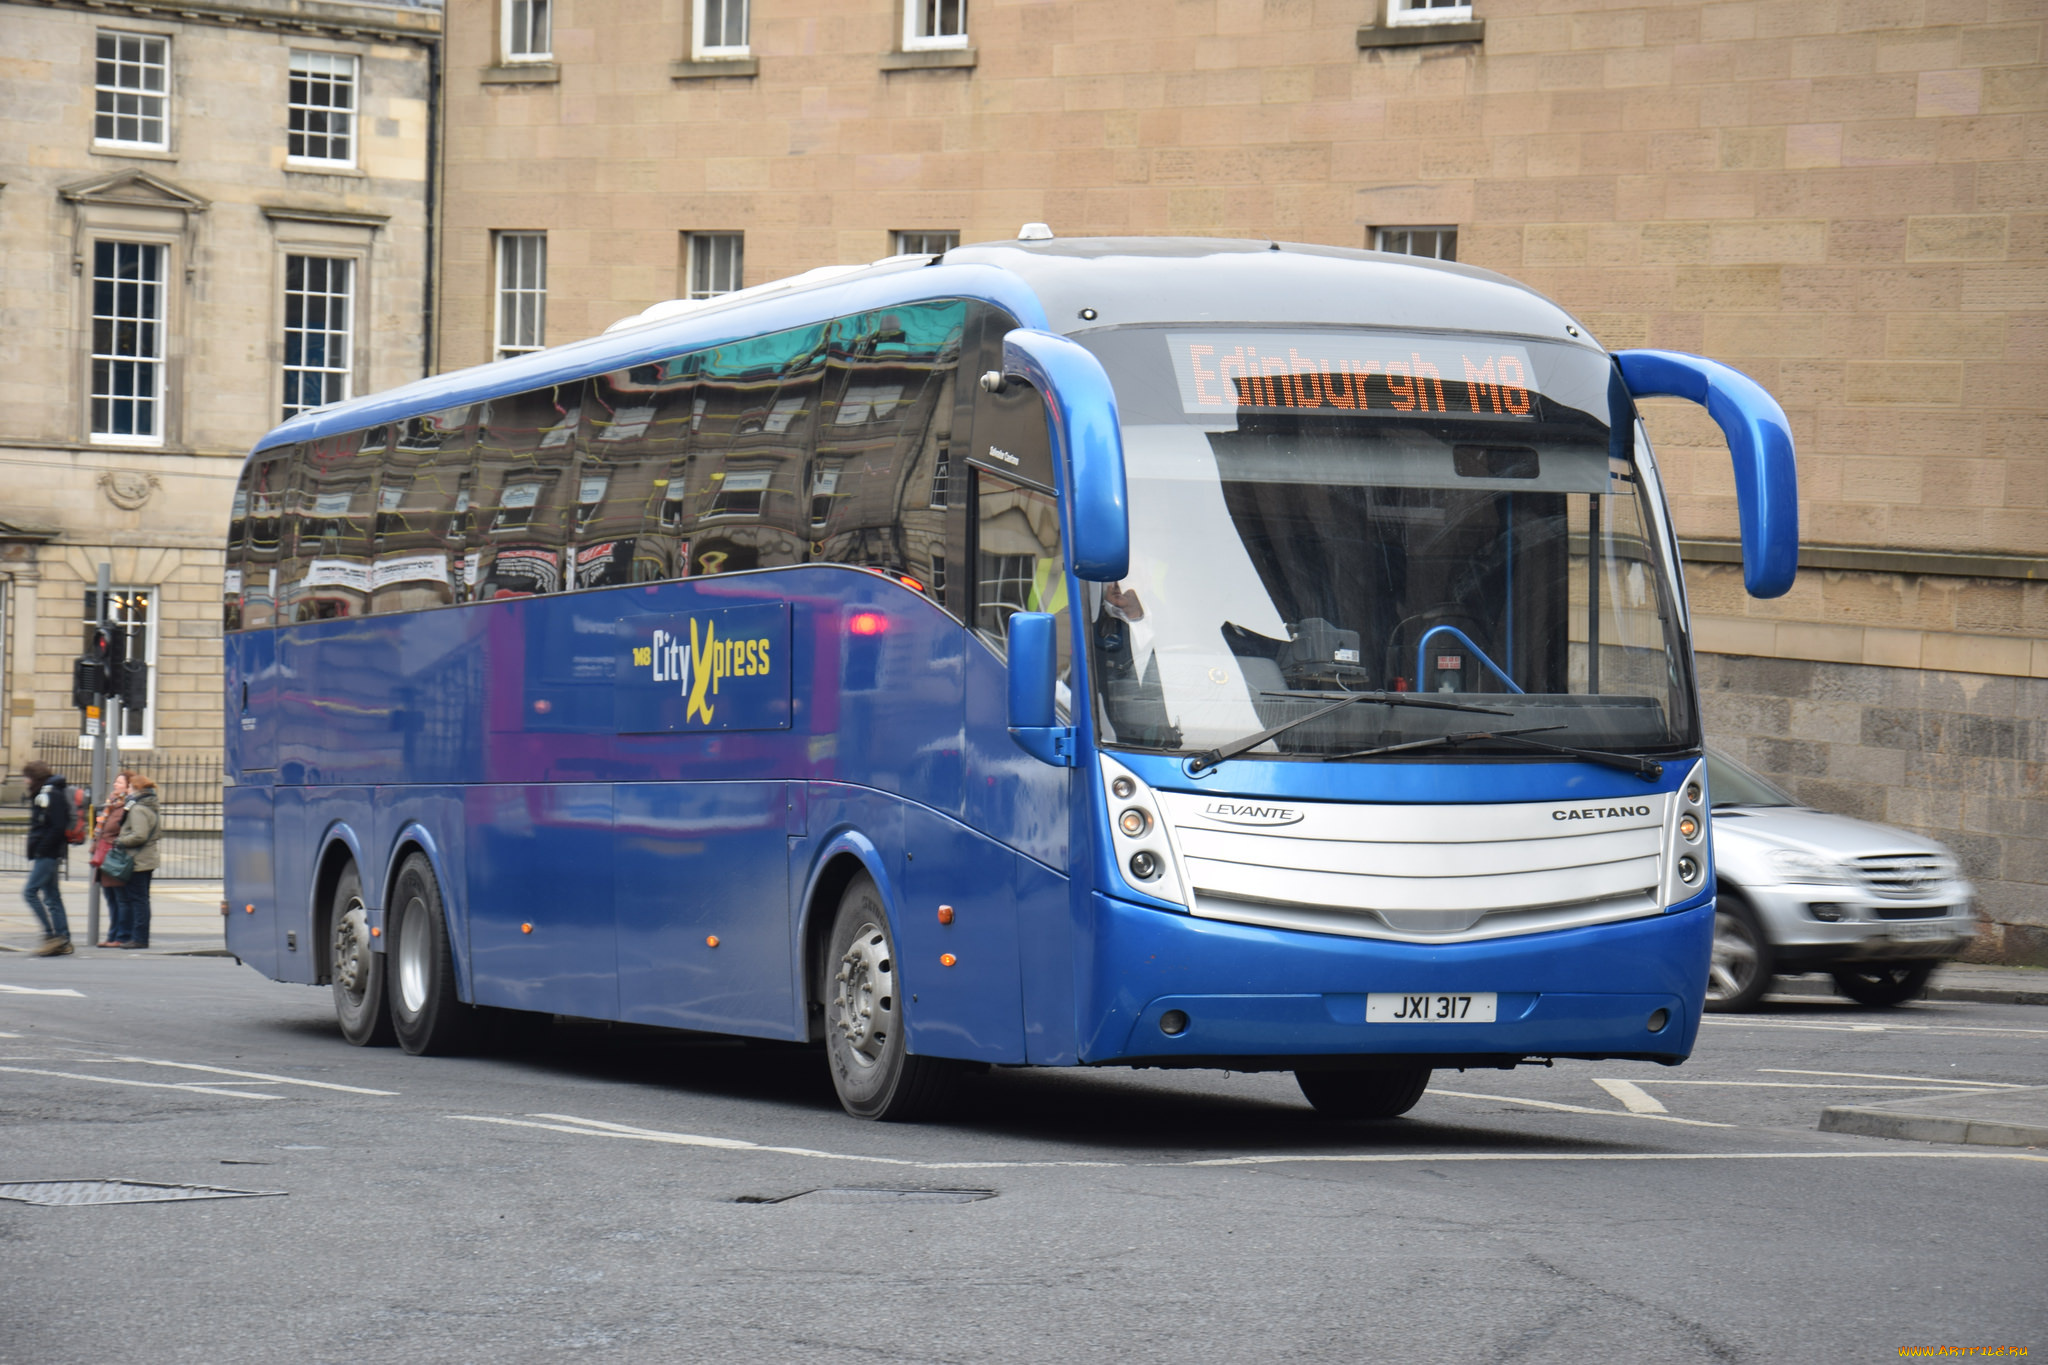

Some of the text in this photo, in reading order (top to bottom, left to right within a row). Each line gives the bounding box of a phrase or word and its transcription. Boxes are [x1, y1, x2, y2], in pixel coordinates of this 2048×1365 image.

[1190, 344, 1530, 415] Edinburgh M8
[632, 646, 651, 666] M8
[1205, 803, 1294, 820] LEVANTE
[1551, 805, 1651, 821] CAETANO
[1393, 996, 1472, 1019] JXI 317
